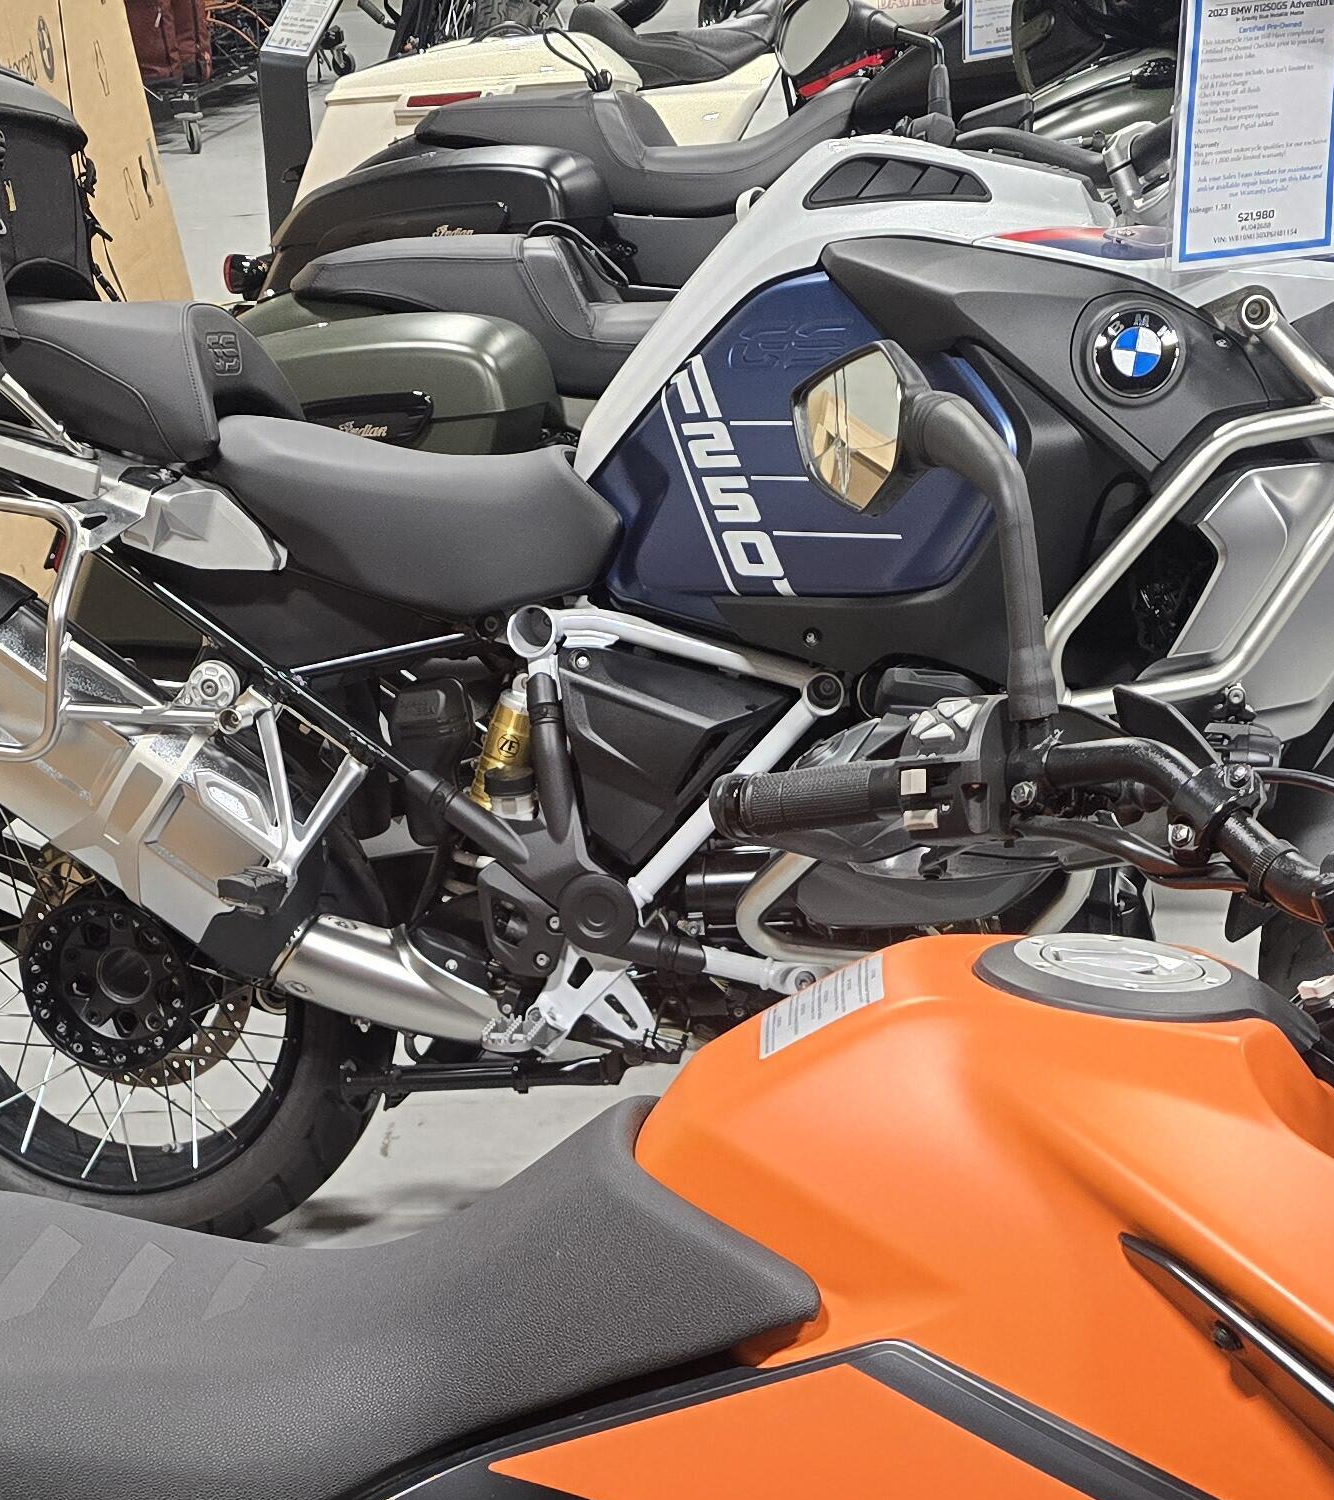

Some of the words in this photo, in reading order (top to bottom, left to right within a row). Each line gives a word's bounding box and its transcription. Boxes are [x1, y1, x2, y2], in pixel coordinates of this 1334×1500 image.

[1209, 8, 1228, 18] 2023
[1231, 6, 1251, 15] BMW
[1254, 0, 1287, 13] R1250GS
[1290, 0, 1334, 10] Adventure
[1239, 25, 1265, 33] Certified
[1267, 21, 1302, 30] Pre-Owned
[1238, 209, 1274, 223] $21,980
[1108, 312, 1178, 343] BMW
[499, 739, 519, 752] ZF
